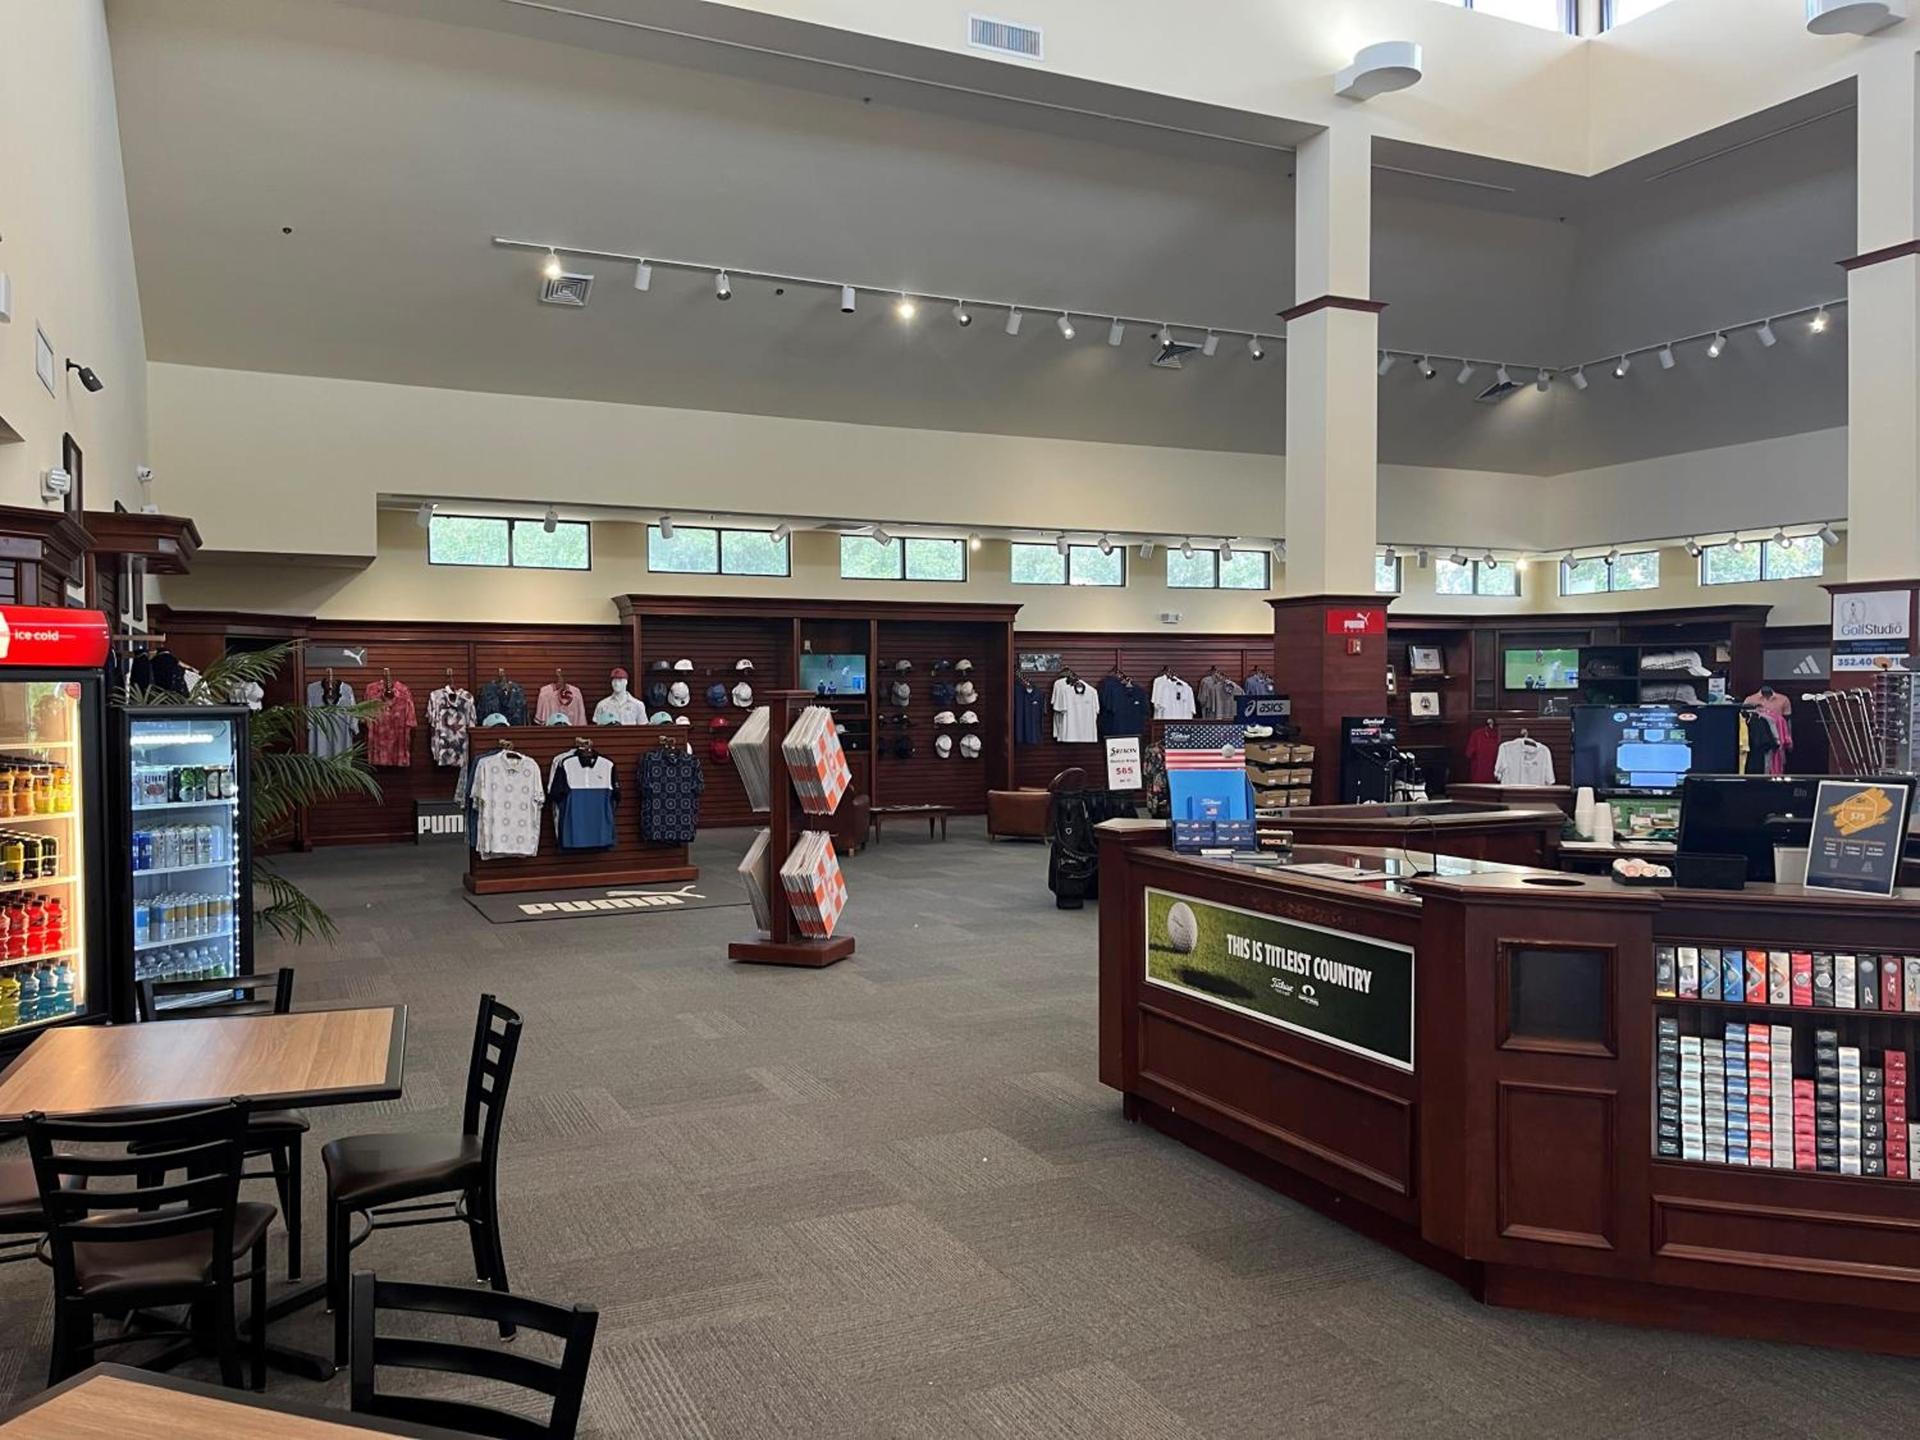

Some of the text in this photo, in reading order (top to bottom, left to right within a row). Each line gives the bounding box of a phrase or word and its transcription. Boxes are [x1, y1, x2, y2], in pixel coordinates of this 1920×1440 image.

[15, 630, 60, 641] ice cold
[418, 814, 466, 834] PUM
[518, 896, 685, 915] PUMA
[1226, 934, 1373, 994] THIS IS TITLEIST COUNTRY
